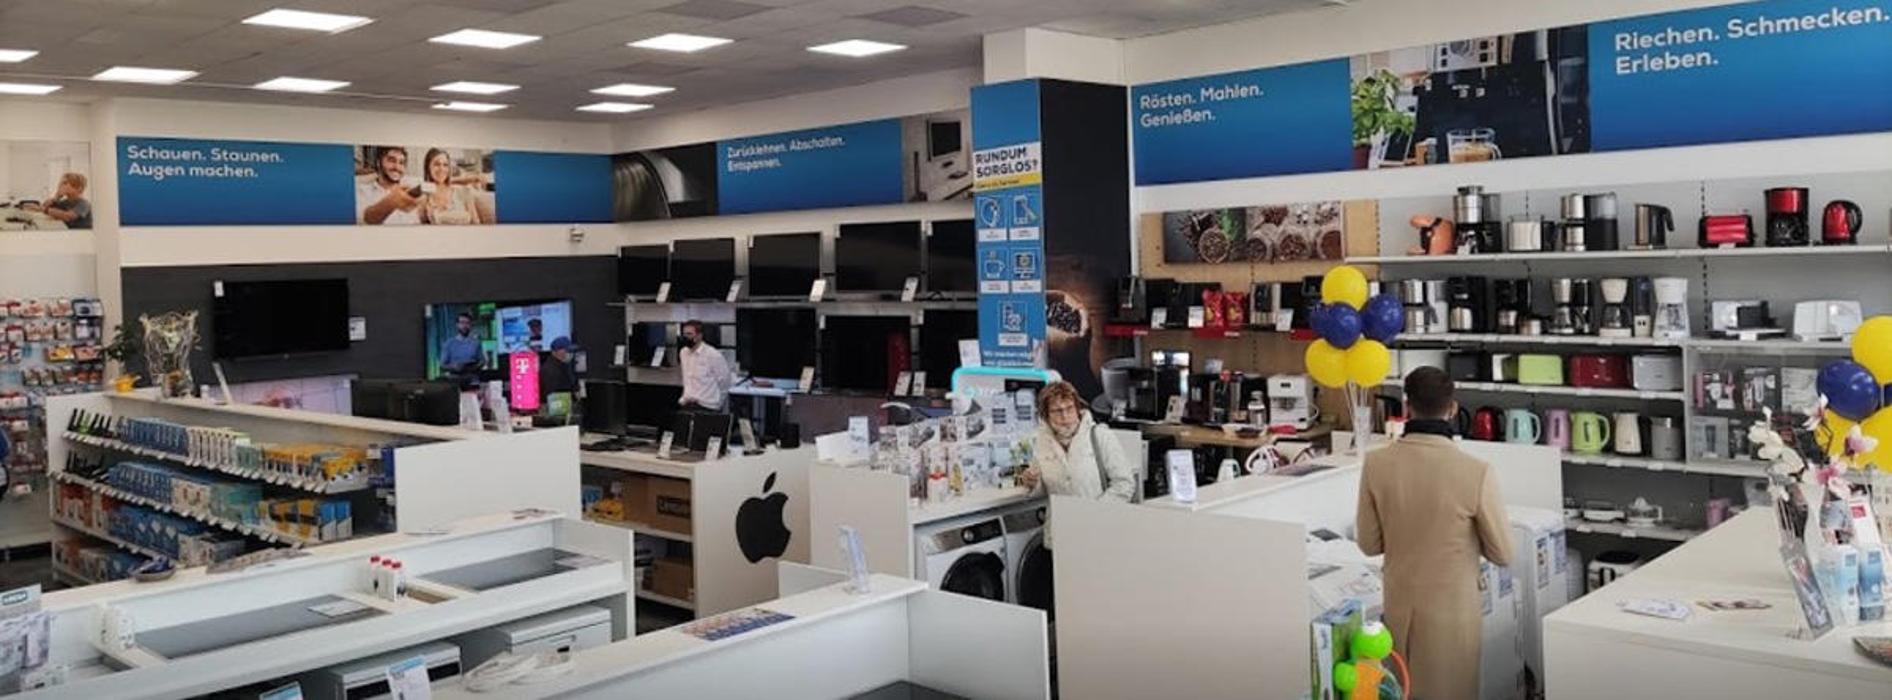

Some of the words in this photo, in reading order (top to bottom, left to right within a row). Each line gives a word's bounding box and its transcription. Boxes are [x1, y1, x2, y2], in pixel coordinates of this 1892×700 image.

[1615, 26, 1720, 51] Riechen.
[1727, 6, 1890, 39] Schmecken.
[1616, 51, 1719, 75] Erleben.
[1140, 93, 1197, 110] Rösten.
[1200, 83, 1264, 102] Mahlen.
[1140, 108, 1216, 127] Genießen.
[127, 145, 206, 161] Schauen.
[210, 147, 284, 163] Staunen.
[727, 142, 788, 159] Zurücklehnen.
[789, 136, 846, 152] Abschalten.
[975, 147, 1026, 164] RUNDUM
[128, 162, 185, 181] Augen
[190, 165, 258, 178] machen.
[727, 158, 782, 174] Entspannen.
[976, 158, 1038, 178] SORGLOS?
